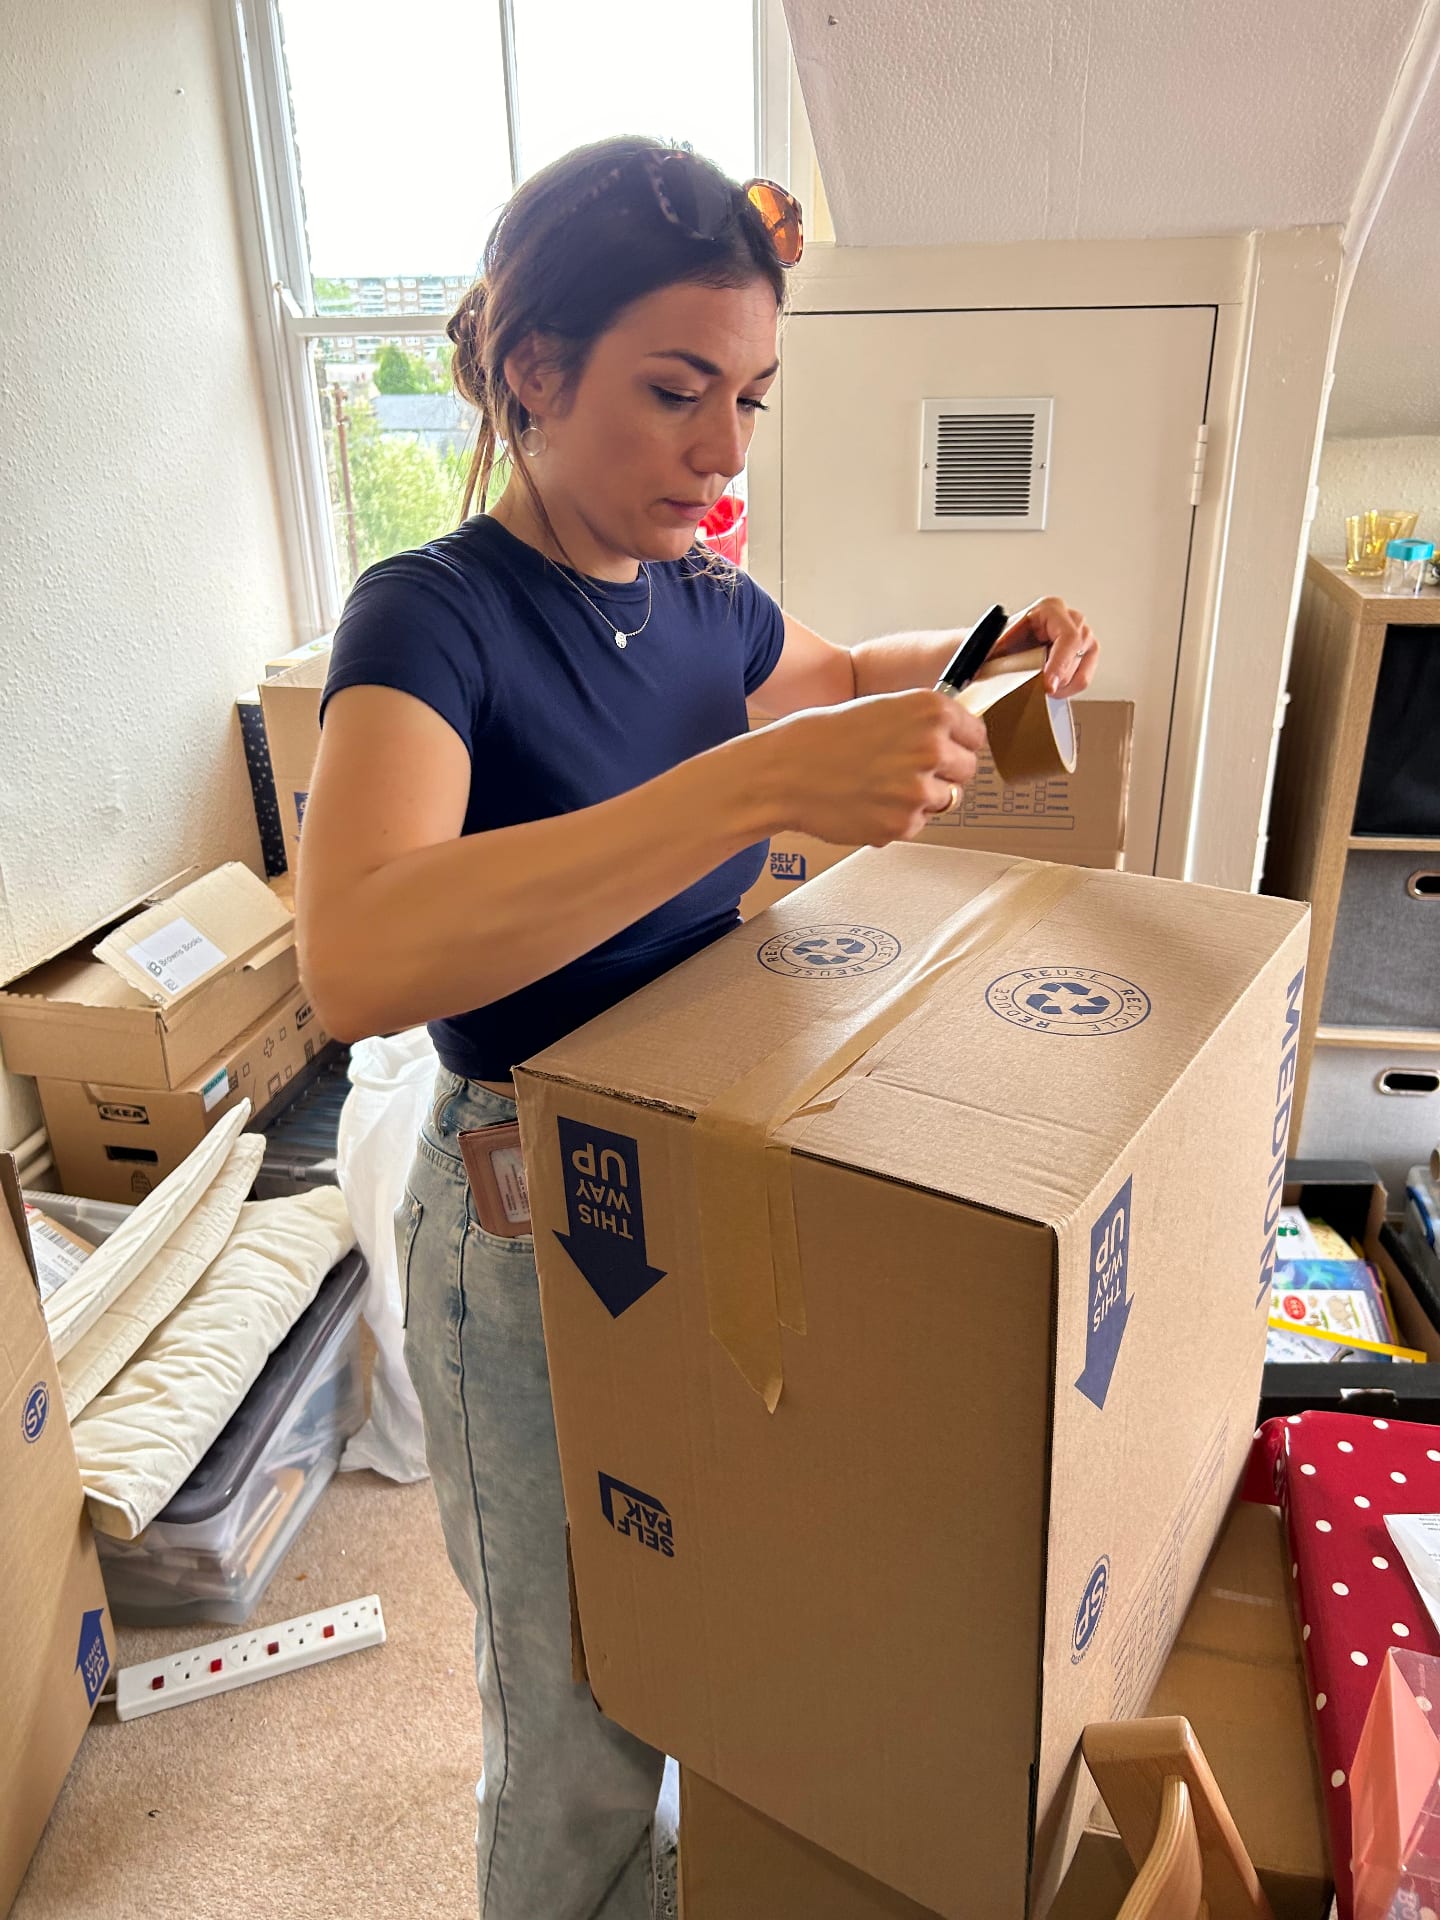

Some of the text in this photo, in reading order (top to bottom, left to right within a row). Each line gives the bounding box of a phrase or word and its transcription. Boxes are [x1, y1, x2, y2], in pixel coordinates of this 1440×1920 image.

[770, 852, 799, 864] SELF
[770, 863, 794, 874] PAK
[765, 927, 819, 963] RECYCLE
[850, 927, 894, 958] REDUCE
[789, 965, 865, 977] REUSE
[1021, 969, 1101, 981] REUSE
[993, 987, 1050, 1029] REDUCE
[1088, 988, 1143, 1032] RECYCLE
[1254, 965, 1305, 1311] MEDIUM
[571, 1143, 628, 1188] UP
[575, 1178, 632, 1214] WAY
[577, 1204, 634, 1241] THIS
[1095, 1207, 1125, 1273] UP
[1094, 1248, 1123, 1307] WAY
[1093, 1277, 1121, 1333] THIS
[26, 1392, 46, 1434] SP
[617, 1515, 675, 1558] SELF
[623, 1495, 674, 1539] PAK
[1076, 1572, 1104, 1646] SP
[89, 1656, 105, 1693] UP
